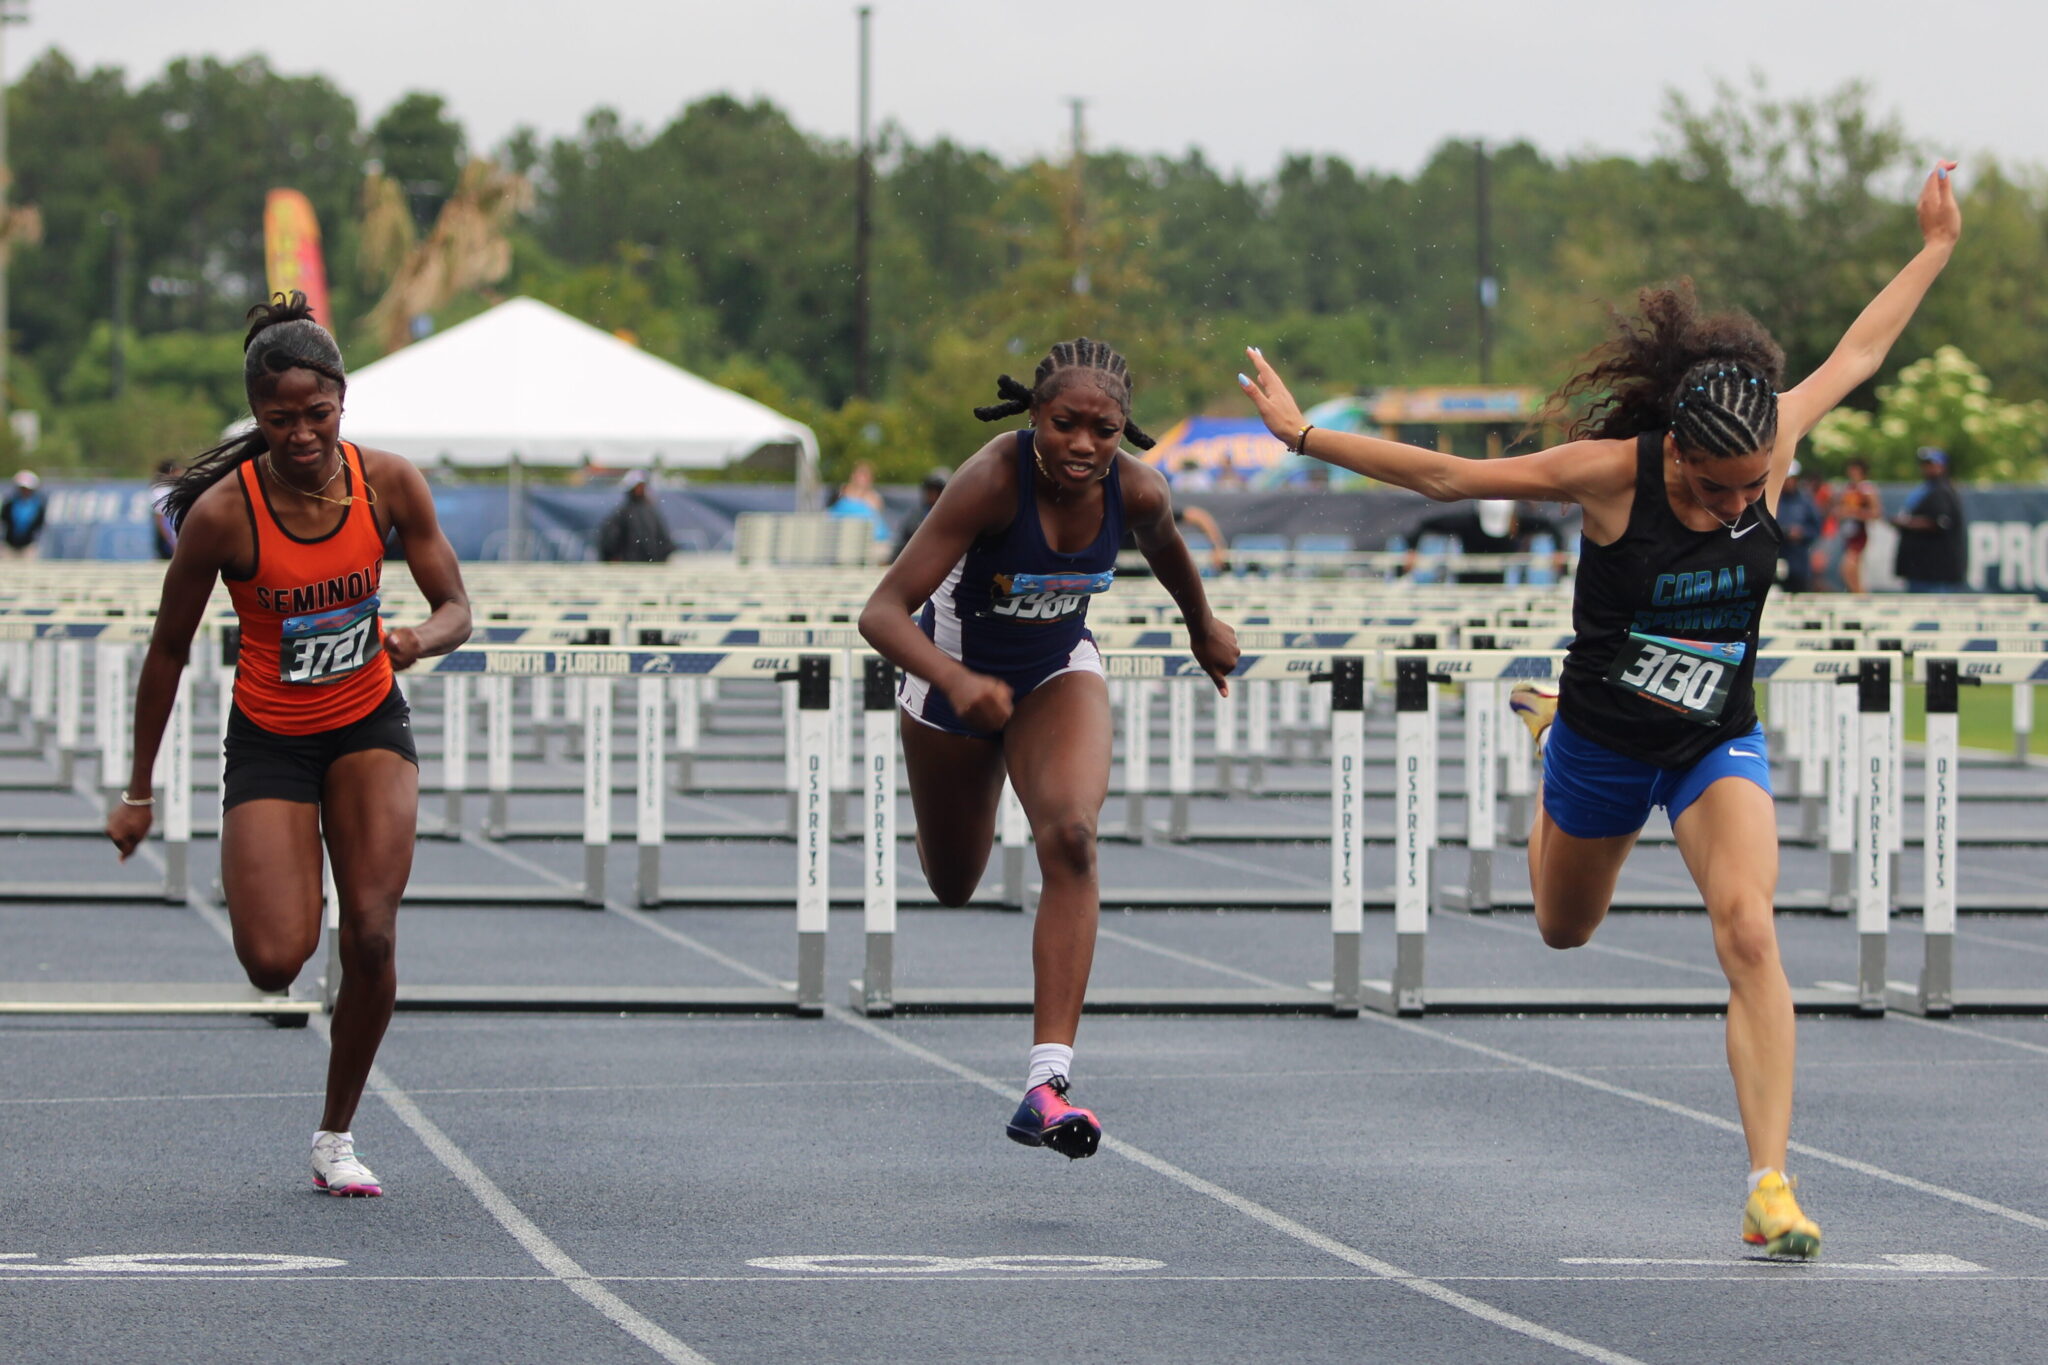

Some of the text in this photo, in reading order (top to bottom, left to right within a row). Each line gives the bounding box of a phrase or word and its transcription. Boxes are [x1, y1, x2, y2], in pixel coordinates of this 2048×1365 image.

[1651, 565, 1750, 607] CORAL
[289, 614, 372, 682] 3727
[486, 652, 630, 673] NORTH FLORIDA
[752, 657, 790, 670] GILL
[1100, 655, 1164, 675] LORIDA
[1286, 660, 1325, 672] GILL
[1435, 660, 1473, 673] GILL
[1813, 662, 1851, 675] GILL
[1965, 662, 2003, 675] GILL
[1620, 643, 1725, 711] 3130
[808, 754, 820, 887] OSPREYS
[873, 754, 885, 887] OSPREYS
[1342, 755, 1352, 887] OSPREYS
[1407, 755, 1418, 887] OSPREYS
[1869, 756, 1880, 888] OSPREYS
[1936, 756, 1947, 889] OSPREYS
